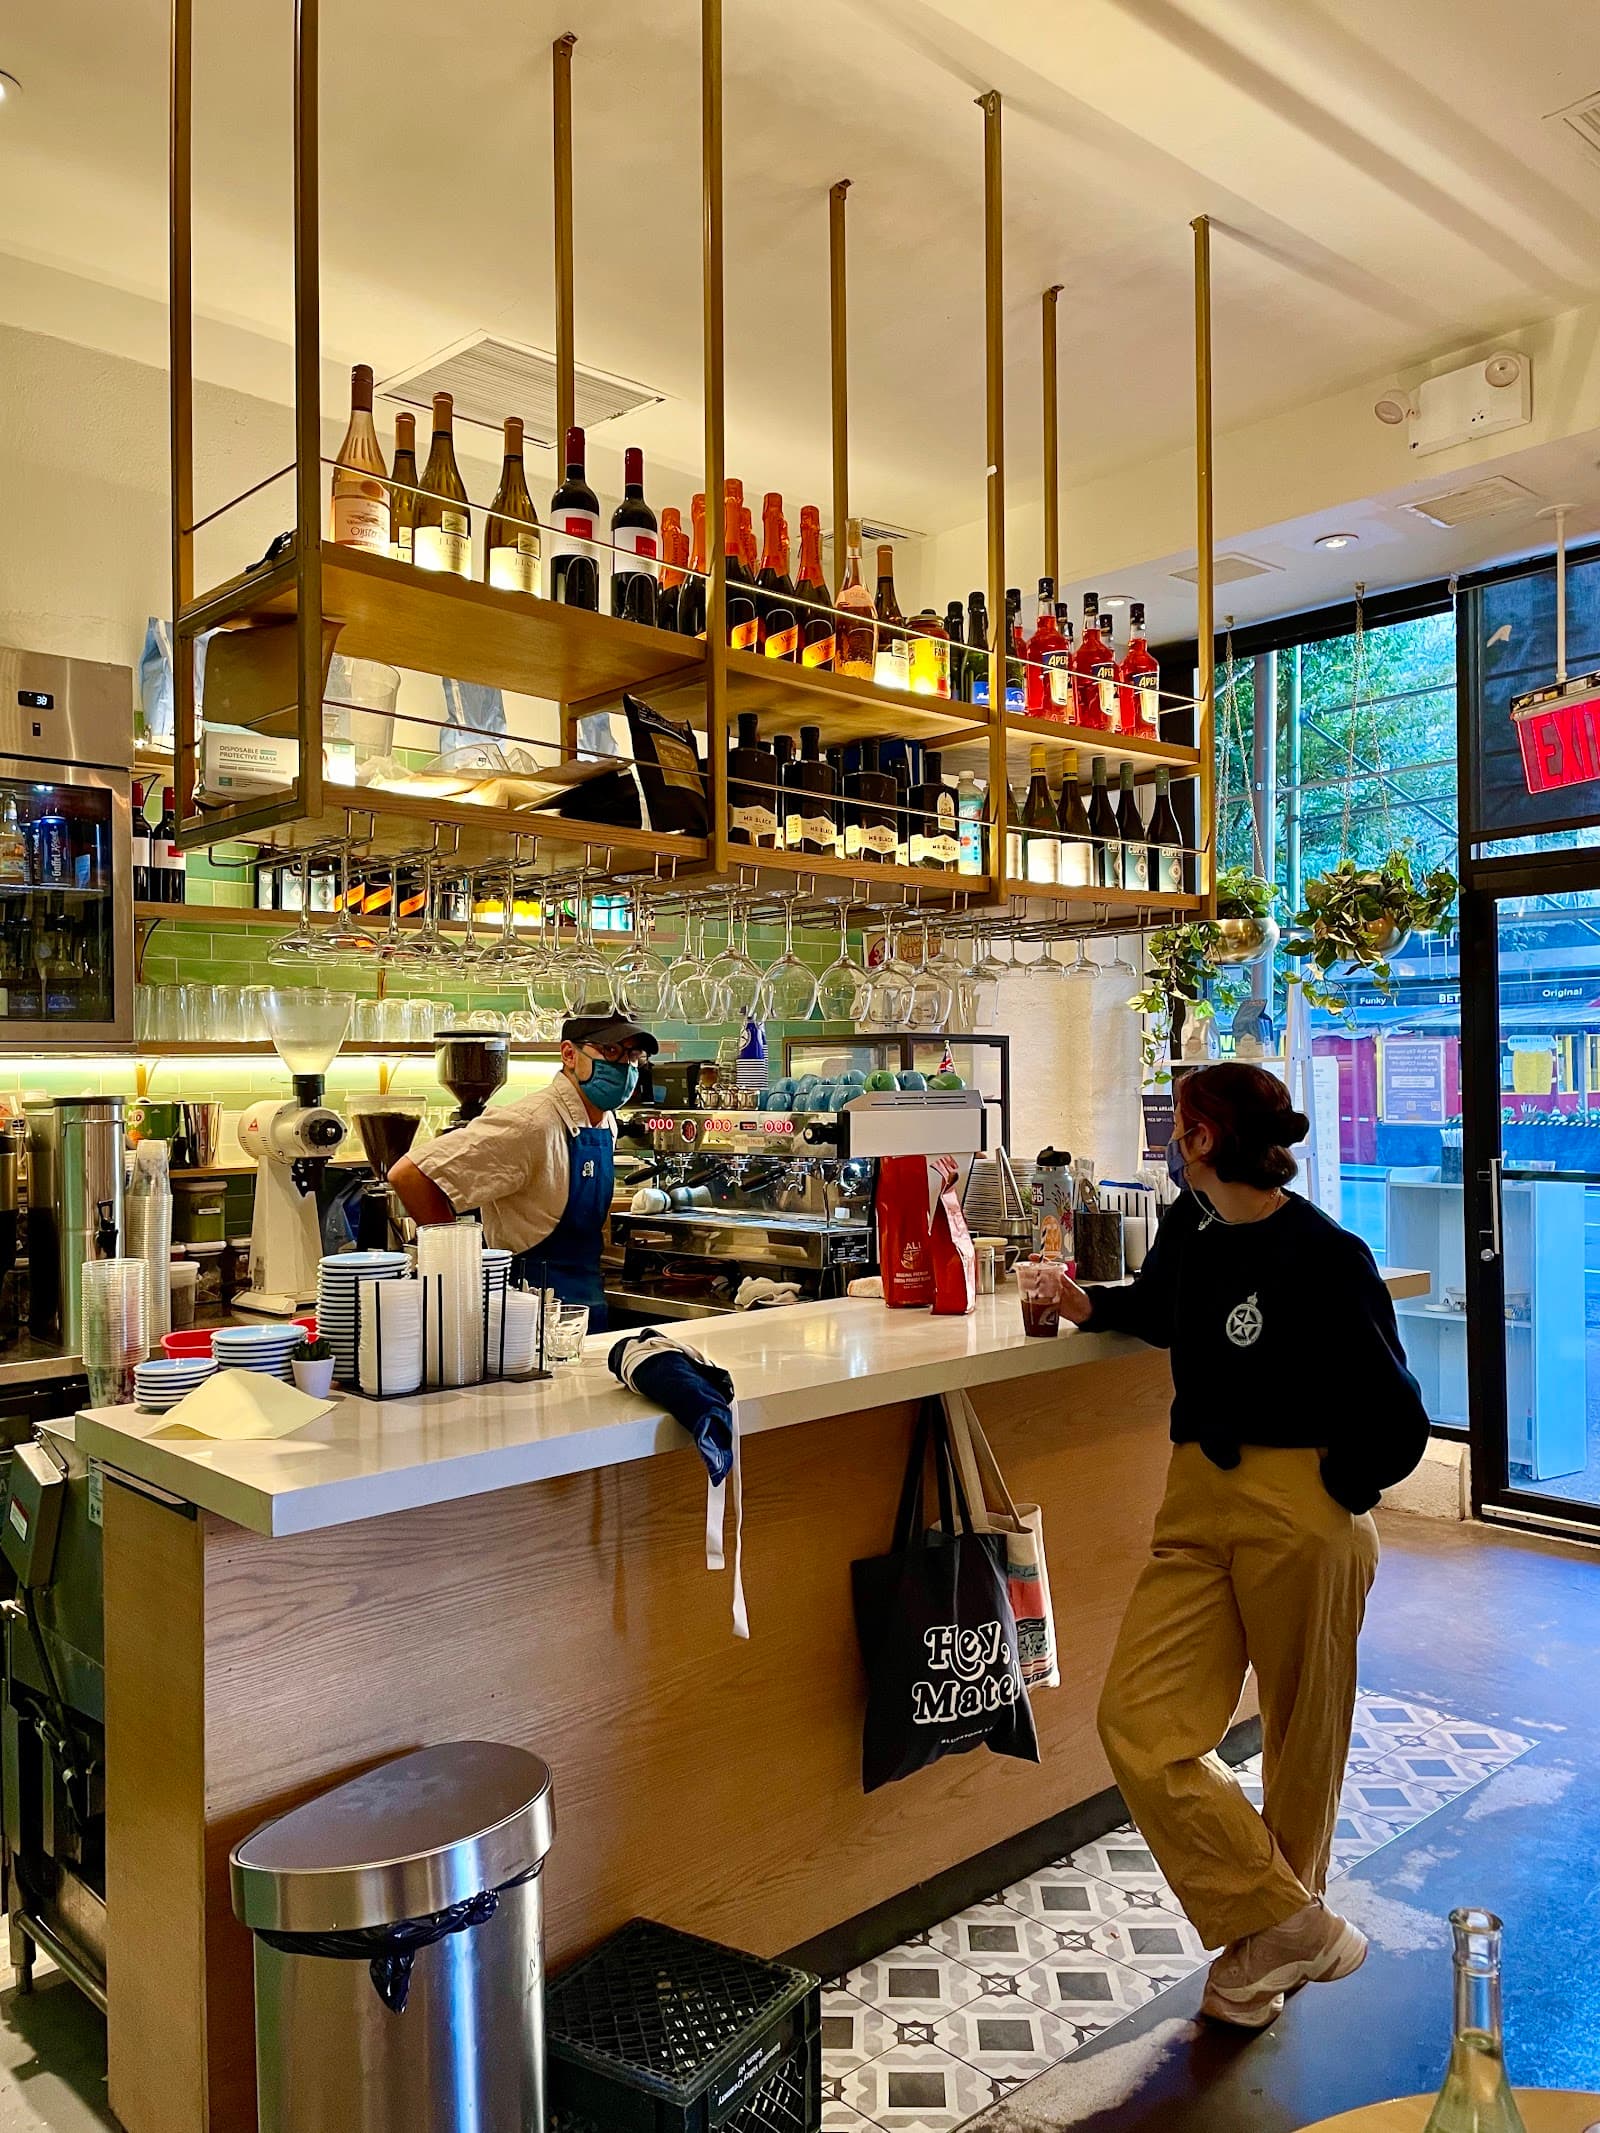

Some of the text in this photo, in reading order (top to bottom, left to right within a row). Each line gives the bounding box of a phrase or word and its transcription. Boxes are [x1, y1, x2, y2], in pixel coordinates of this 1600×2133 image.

[1531, 698, 1600, 789] EXIT
[219, 745, 259, 754] DISPOSABLE
[219, 752, 258, 760] PROTECTIVE
[755, 816, 772, 825] BLACK
[1542, 987, 1583, 998] Original
[1359, 996, 1387, 1006] Funky
[923, 1620, 1012, 1682] Hey,
